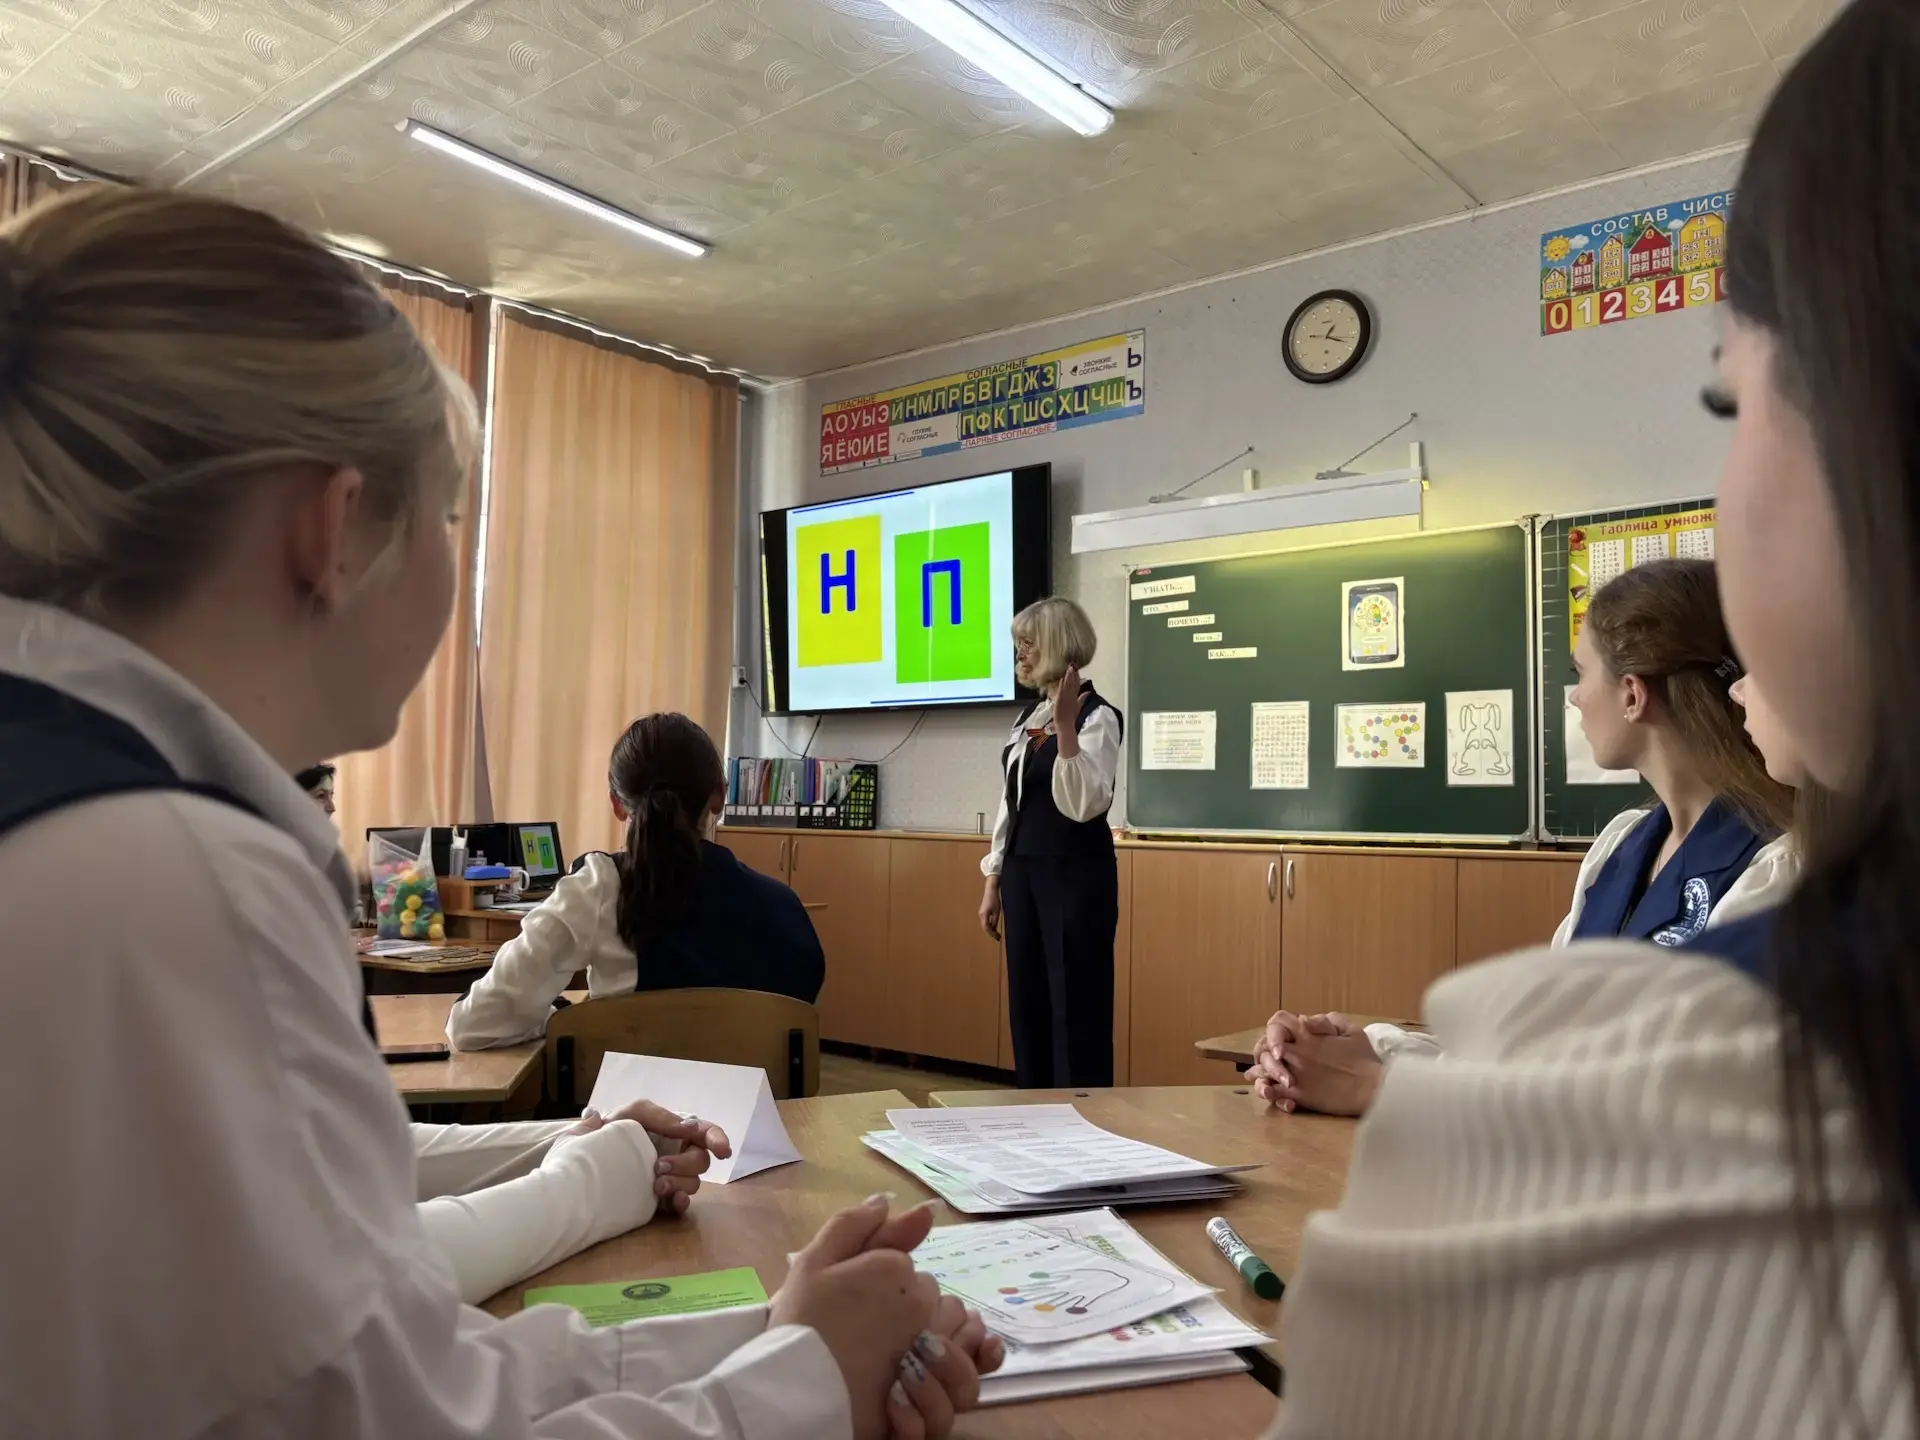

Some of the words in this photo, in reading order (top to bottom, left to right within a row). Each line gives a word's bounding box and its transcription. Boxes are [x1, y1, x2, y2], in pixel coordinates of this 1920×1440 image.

[1591, 208, 1668, 236] СОСТАВ
[1550, 302, 1568, 329] 0
[1577, 297, 1592, 324] 1
[1603, 291, 1624, 320] 2
[1631, 286, 1652, 313] 3
[1657, 280, 1680, 307] 4
[1689, 273, 1711, 302] 5
[1079, 361, 1118, 376] СОГЛАСНЫЕ
[1127, 347, 1142, 369] Ь
[966, 358, 1028, 381] СОГЛАСНЫЕ
[1126, 379, 1142, 401] Ъ
[835, 395, 877, 411] ГЛАСНЫЕ
[1601, 520, 1658, 536] Таблица
[821, 550, 856, 614] Н
[922, 559, 961, 627] П
[526, 839, 535, 854] Н
[541, 843, 550, 857] П
[1658, 933, 1676, 945] 1930
